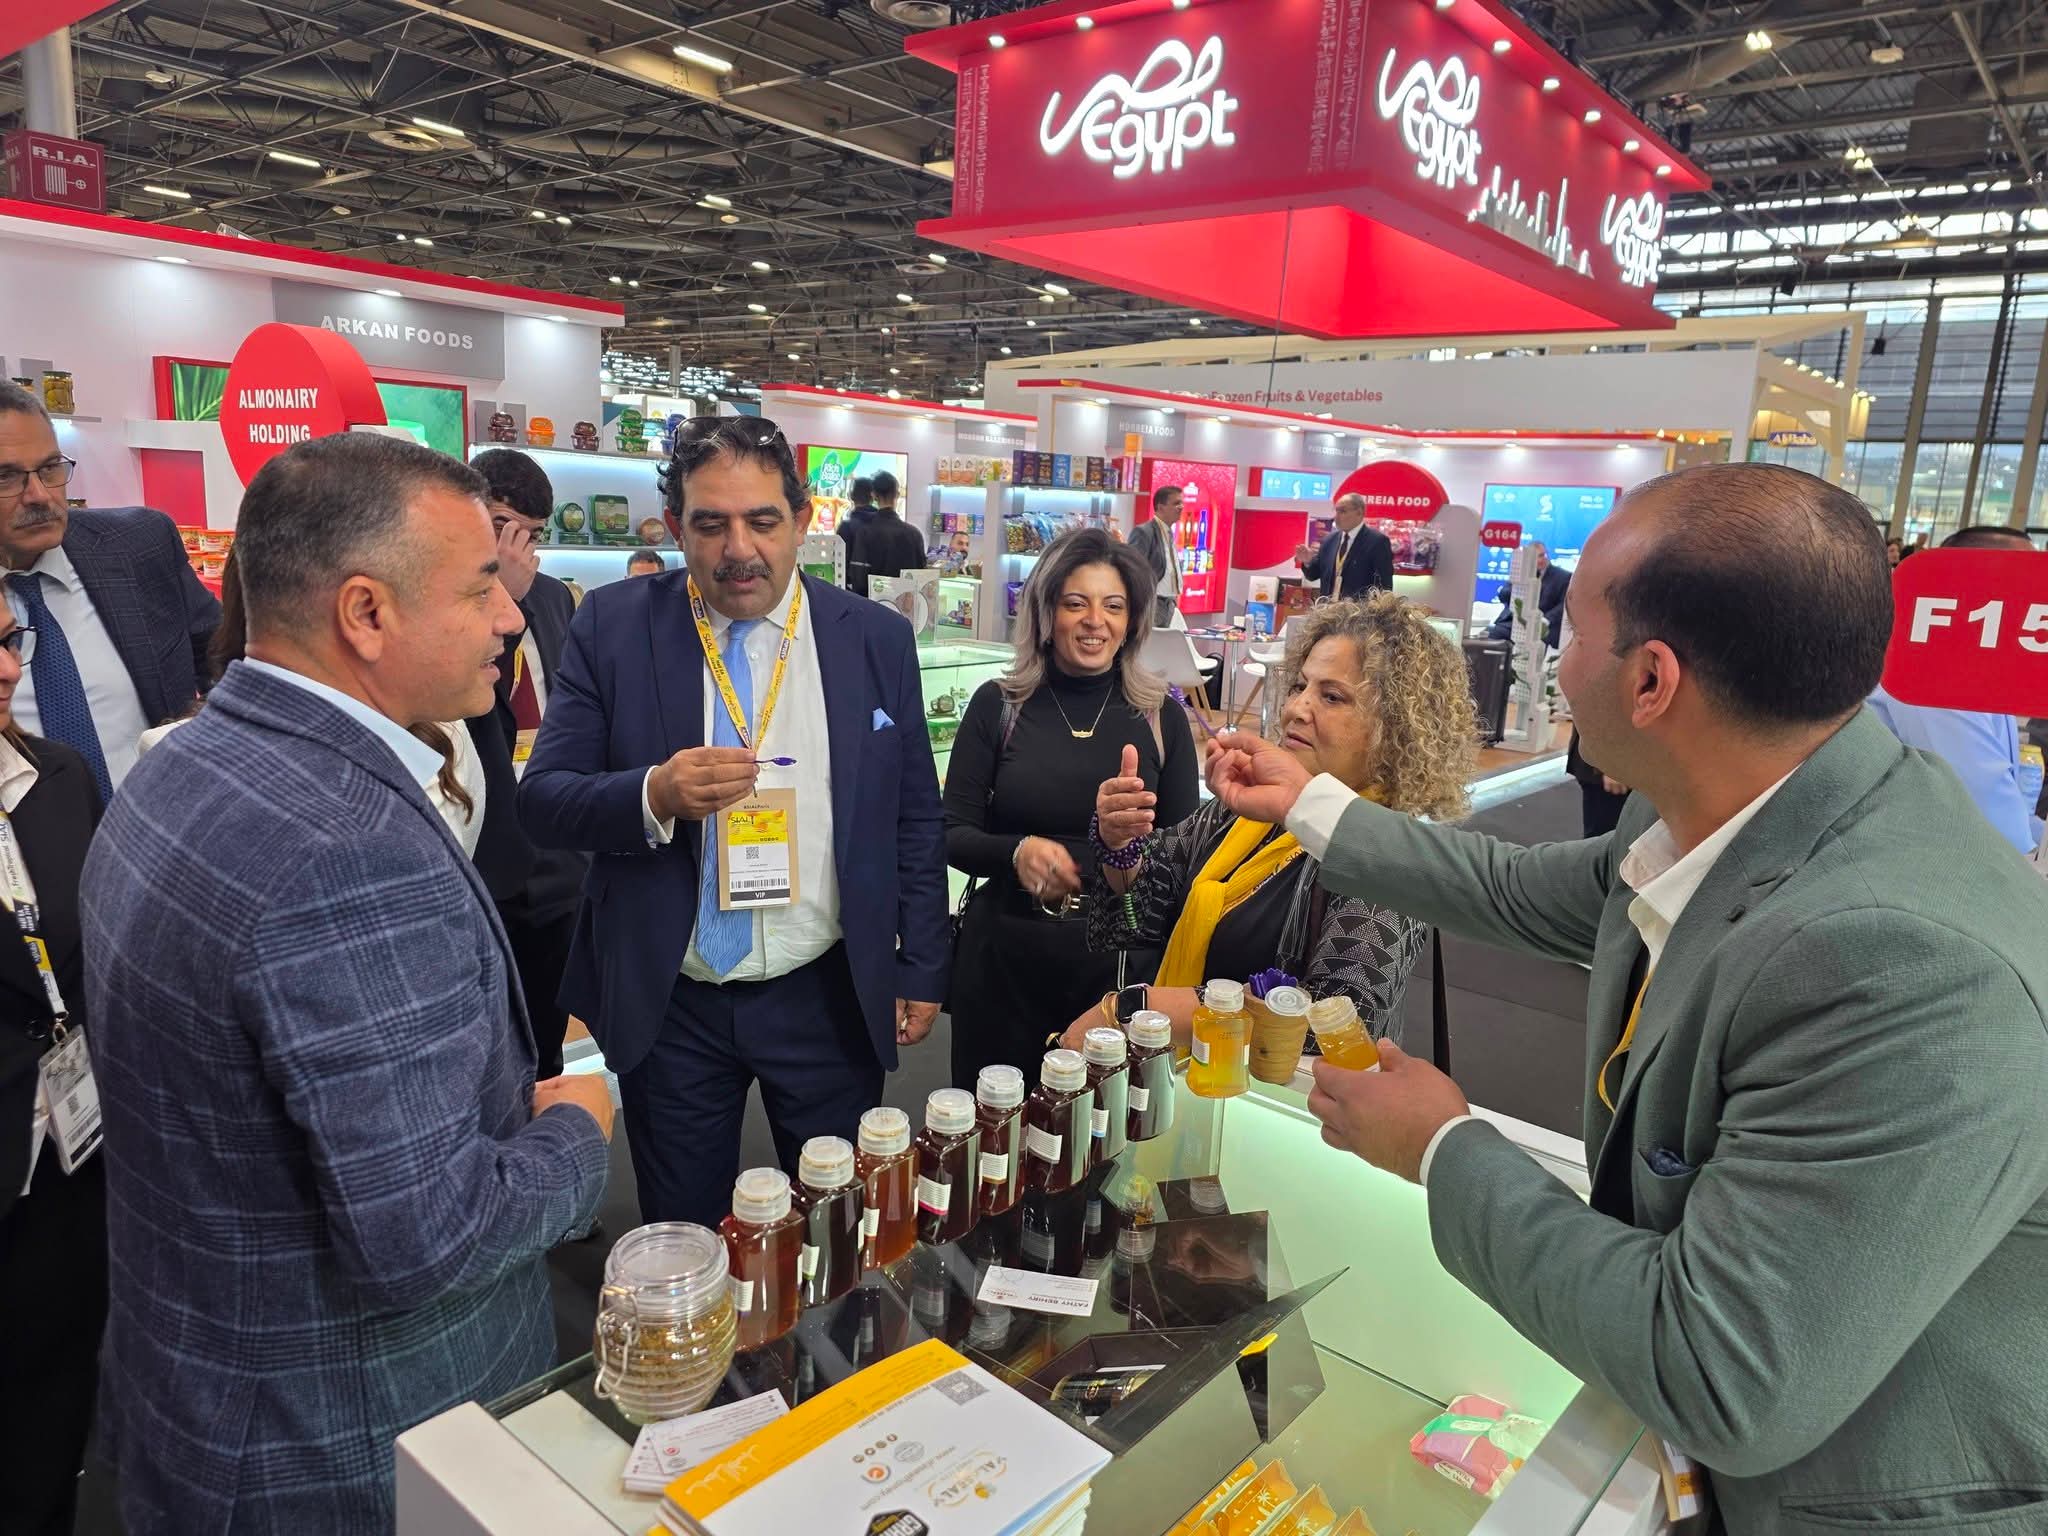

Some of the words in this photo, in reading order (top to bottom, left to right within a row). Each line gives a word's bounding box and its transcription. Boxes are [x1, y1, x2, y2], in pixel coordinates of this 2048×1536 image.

[1079, 86, 1239, 179] Egypt
[1401, 84, 1483, 190] Egypt
[31, 145, 97, 168] R.I.A.
[1614, 214, 1663, 289] Egypt
[320, 315, 399, 341] ARKAN
[404, 327, 474, 350] FOODS
[238, 387, 319, 409] ALMONAIRY
[1211, 390, 1252, 404] Fozen
[1254, 390, 1297, 403] Fruits
[1295, 389, 1305, 402] &
[1308, 388, 1383, 405] Vegetables
[249, 424, 311, 444] HOLDING
[1154, 426, 1176, 437] FOOD
[1396, 496, 1431, 507] FOOD
[1484, 529, 1519, 541] G164
